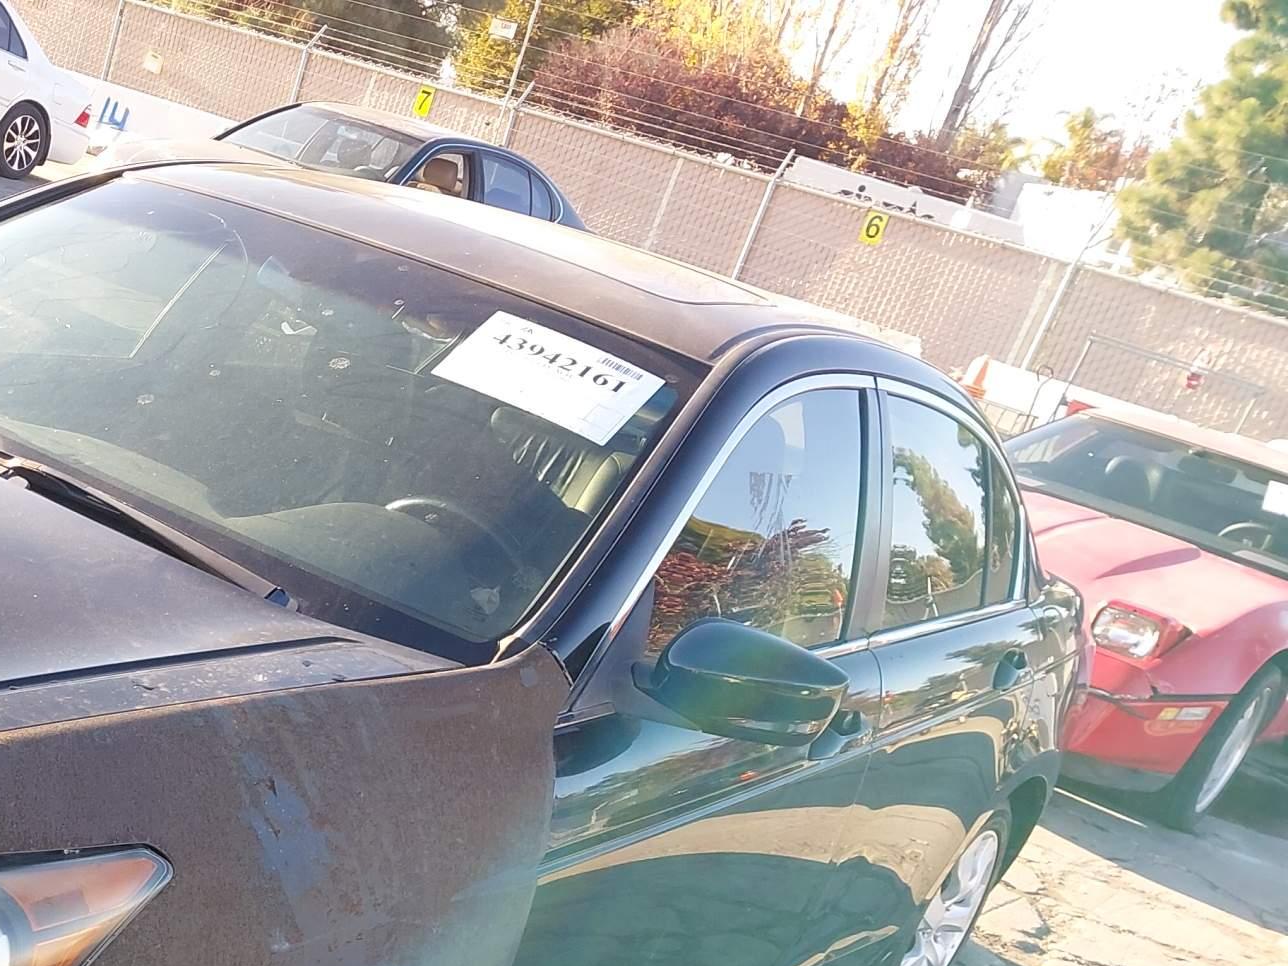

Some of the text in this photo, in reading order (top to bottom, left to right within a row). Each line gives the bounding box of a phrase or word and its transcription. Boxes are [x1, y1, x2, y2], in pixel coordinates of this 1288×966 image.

[96, 95, 130, 132] 14
[419, 89, 432, 111] 7
[865, 214, 883, 239] 6
[493, 334, 627, 393] 43942161
